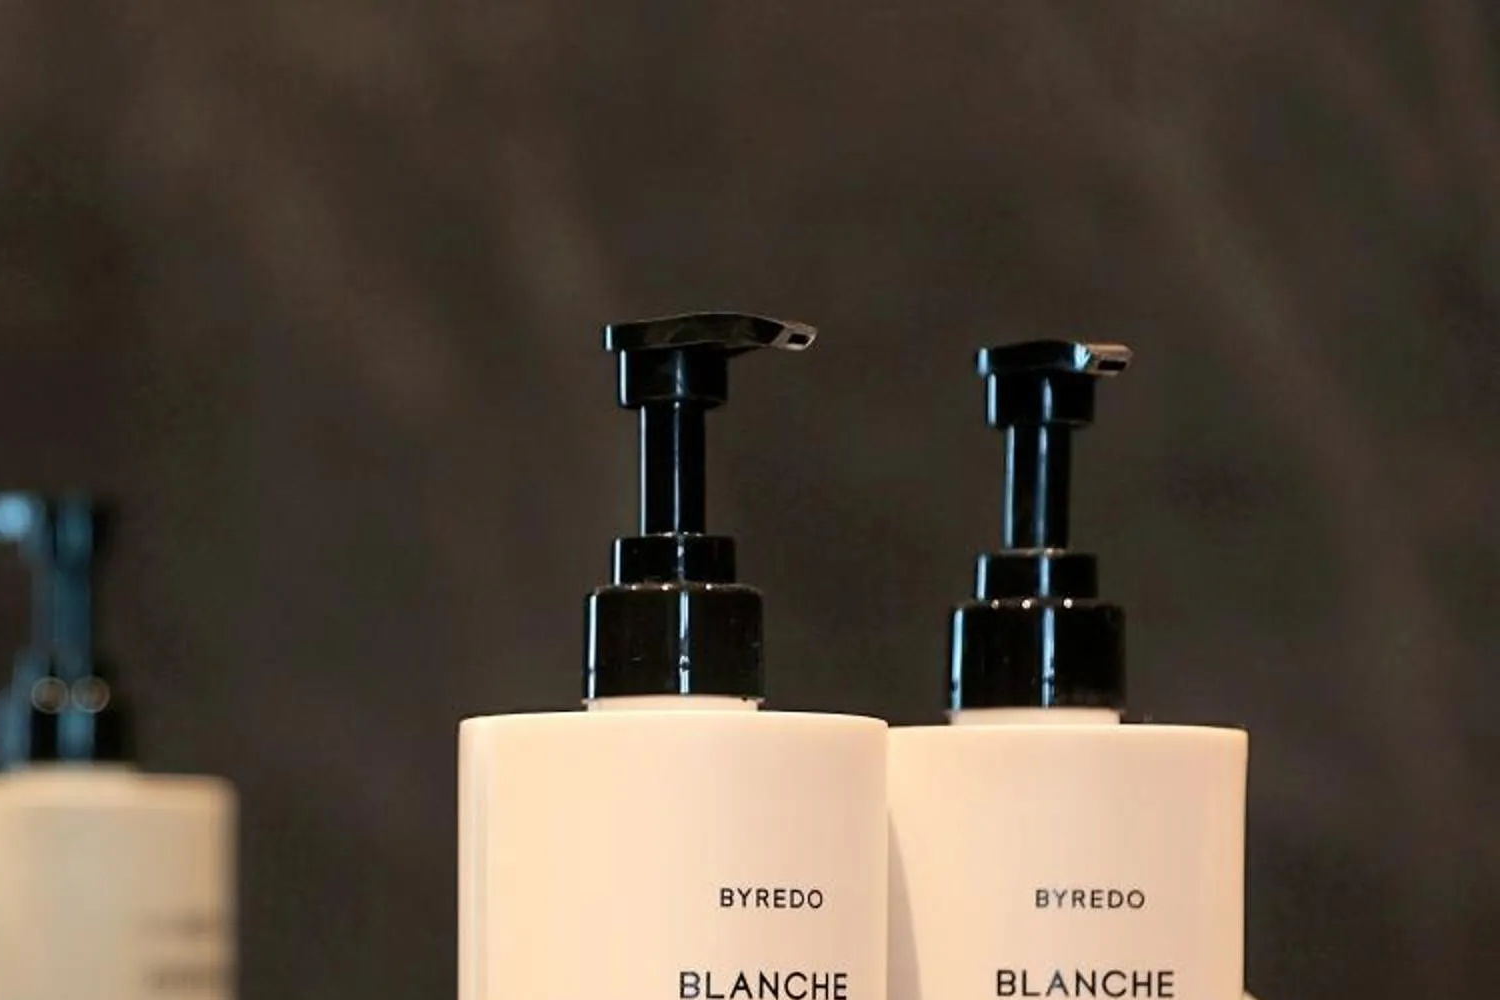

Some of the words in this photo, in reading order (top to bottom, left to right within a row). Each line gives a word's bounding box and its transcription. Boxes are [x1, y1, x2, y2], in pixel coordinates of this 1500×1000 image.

[720, 887, 824, 909] BYREDO
[1035, 888, 1146, 909] BYREDO
[679, 970, 849, 1000] BLANCHE
[996, 968, 1175, 998] BLANCHE
